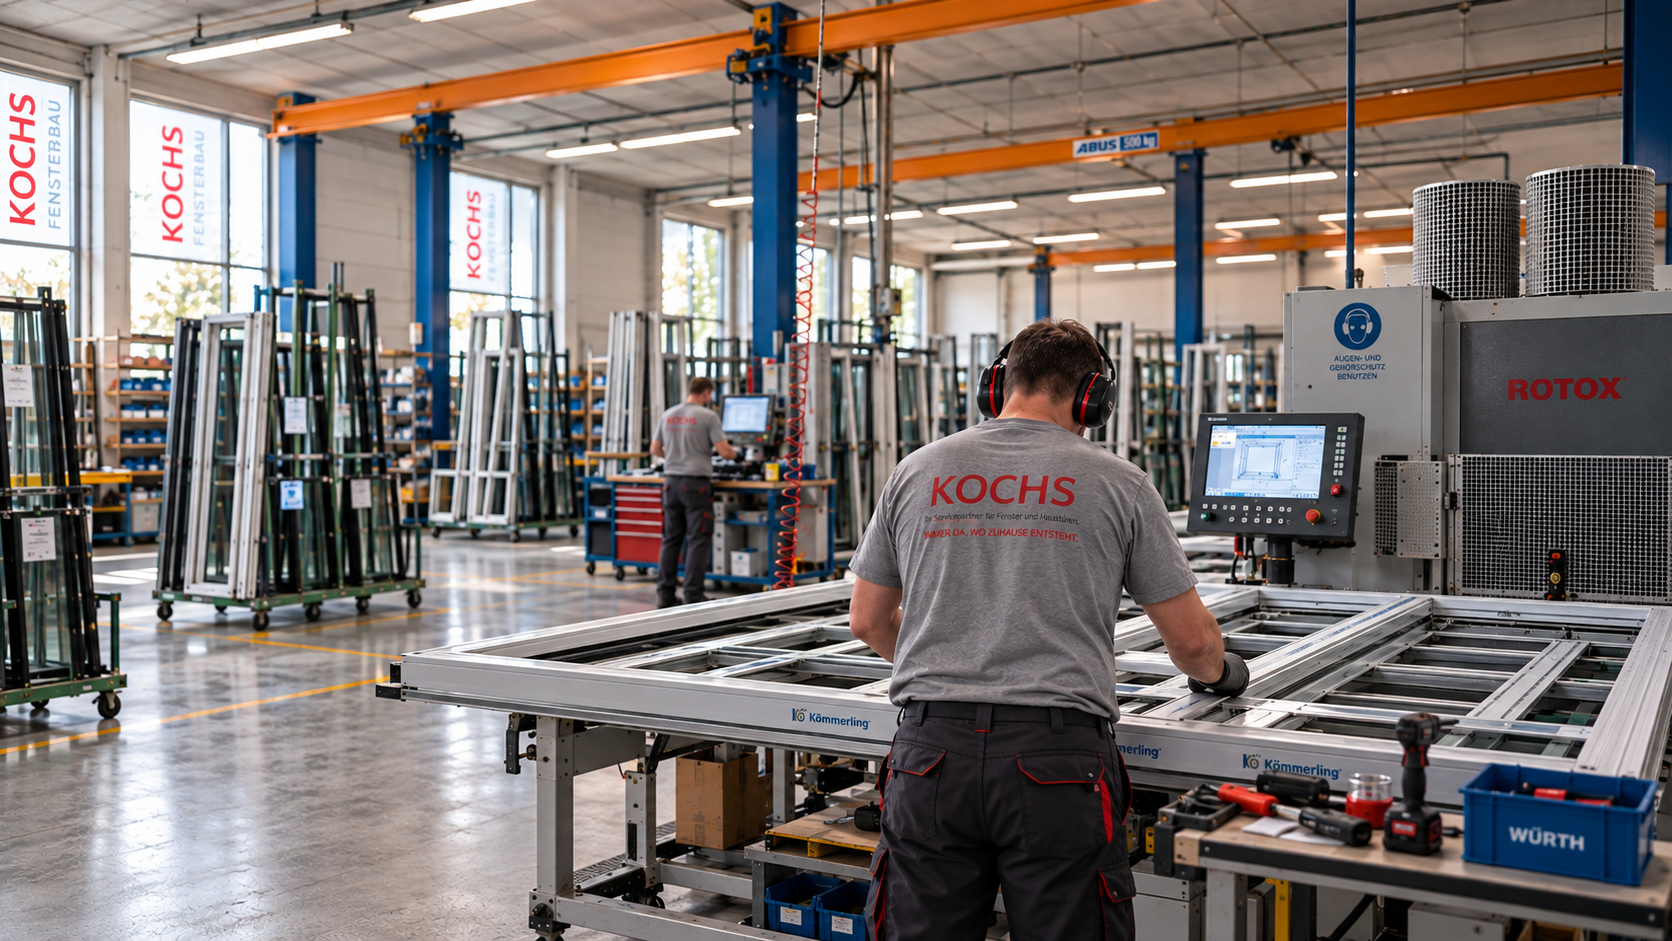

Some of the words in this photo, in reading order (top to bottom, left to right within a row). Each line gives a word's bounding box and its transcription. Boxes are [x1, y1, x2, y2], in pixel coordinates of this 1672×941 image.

[9, 92, 36, 226] KOCHS
[1077, 139, 1117, 154] ABUS
[48, 99, 61, 230] FENSTERBAU
[161, 125, 184, 243] KOCHS
[193, 129, 205, 247] FENSTERBAU
[466, 190, 482, 279] KOCHS
[1333, 354, 1363, 362] AUGEN-
[1364, 354, 1382, 362] UND
[1337, 372, 1378, 380] BENUTZEN
[1507, 376, 1623, 401] ROTOX
[930, 474, 1076, 507] KOCHS
[970, 528, 987, 537] WO
[987, 528, 1029, 537] ZUHAUSE
[1030, 529, 1079, 543] ENTSTEHT.
[809, 712, 869, 730] Kömmerling
[1264, 759, 1340, 781] Kömmerling
[1508, 826, 1585, 852] WÜRTH
